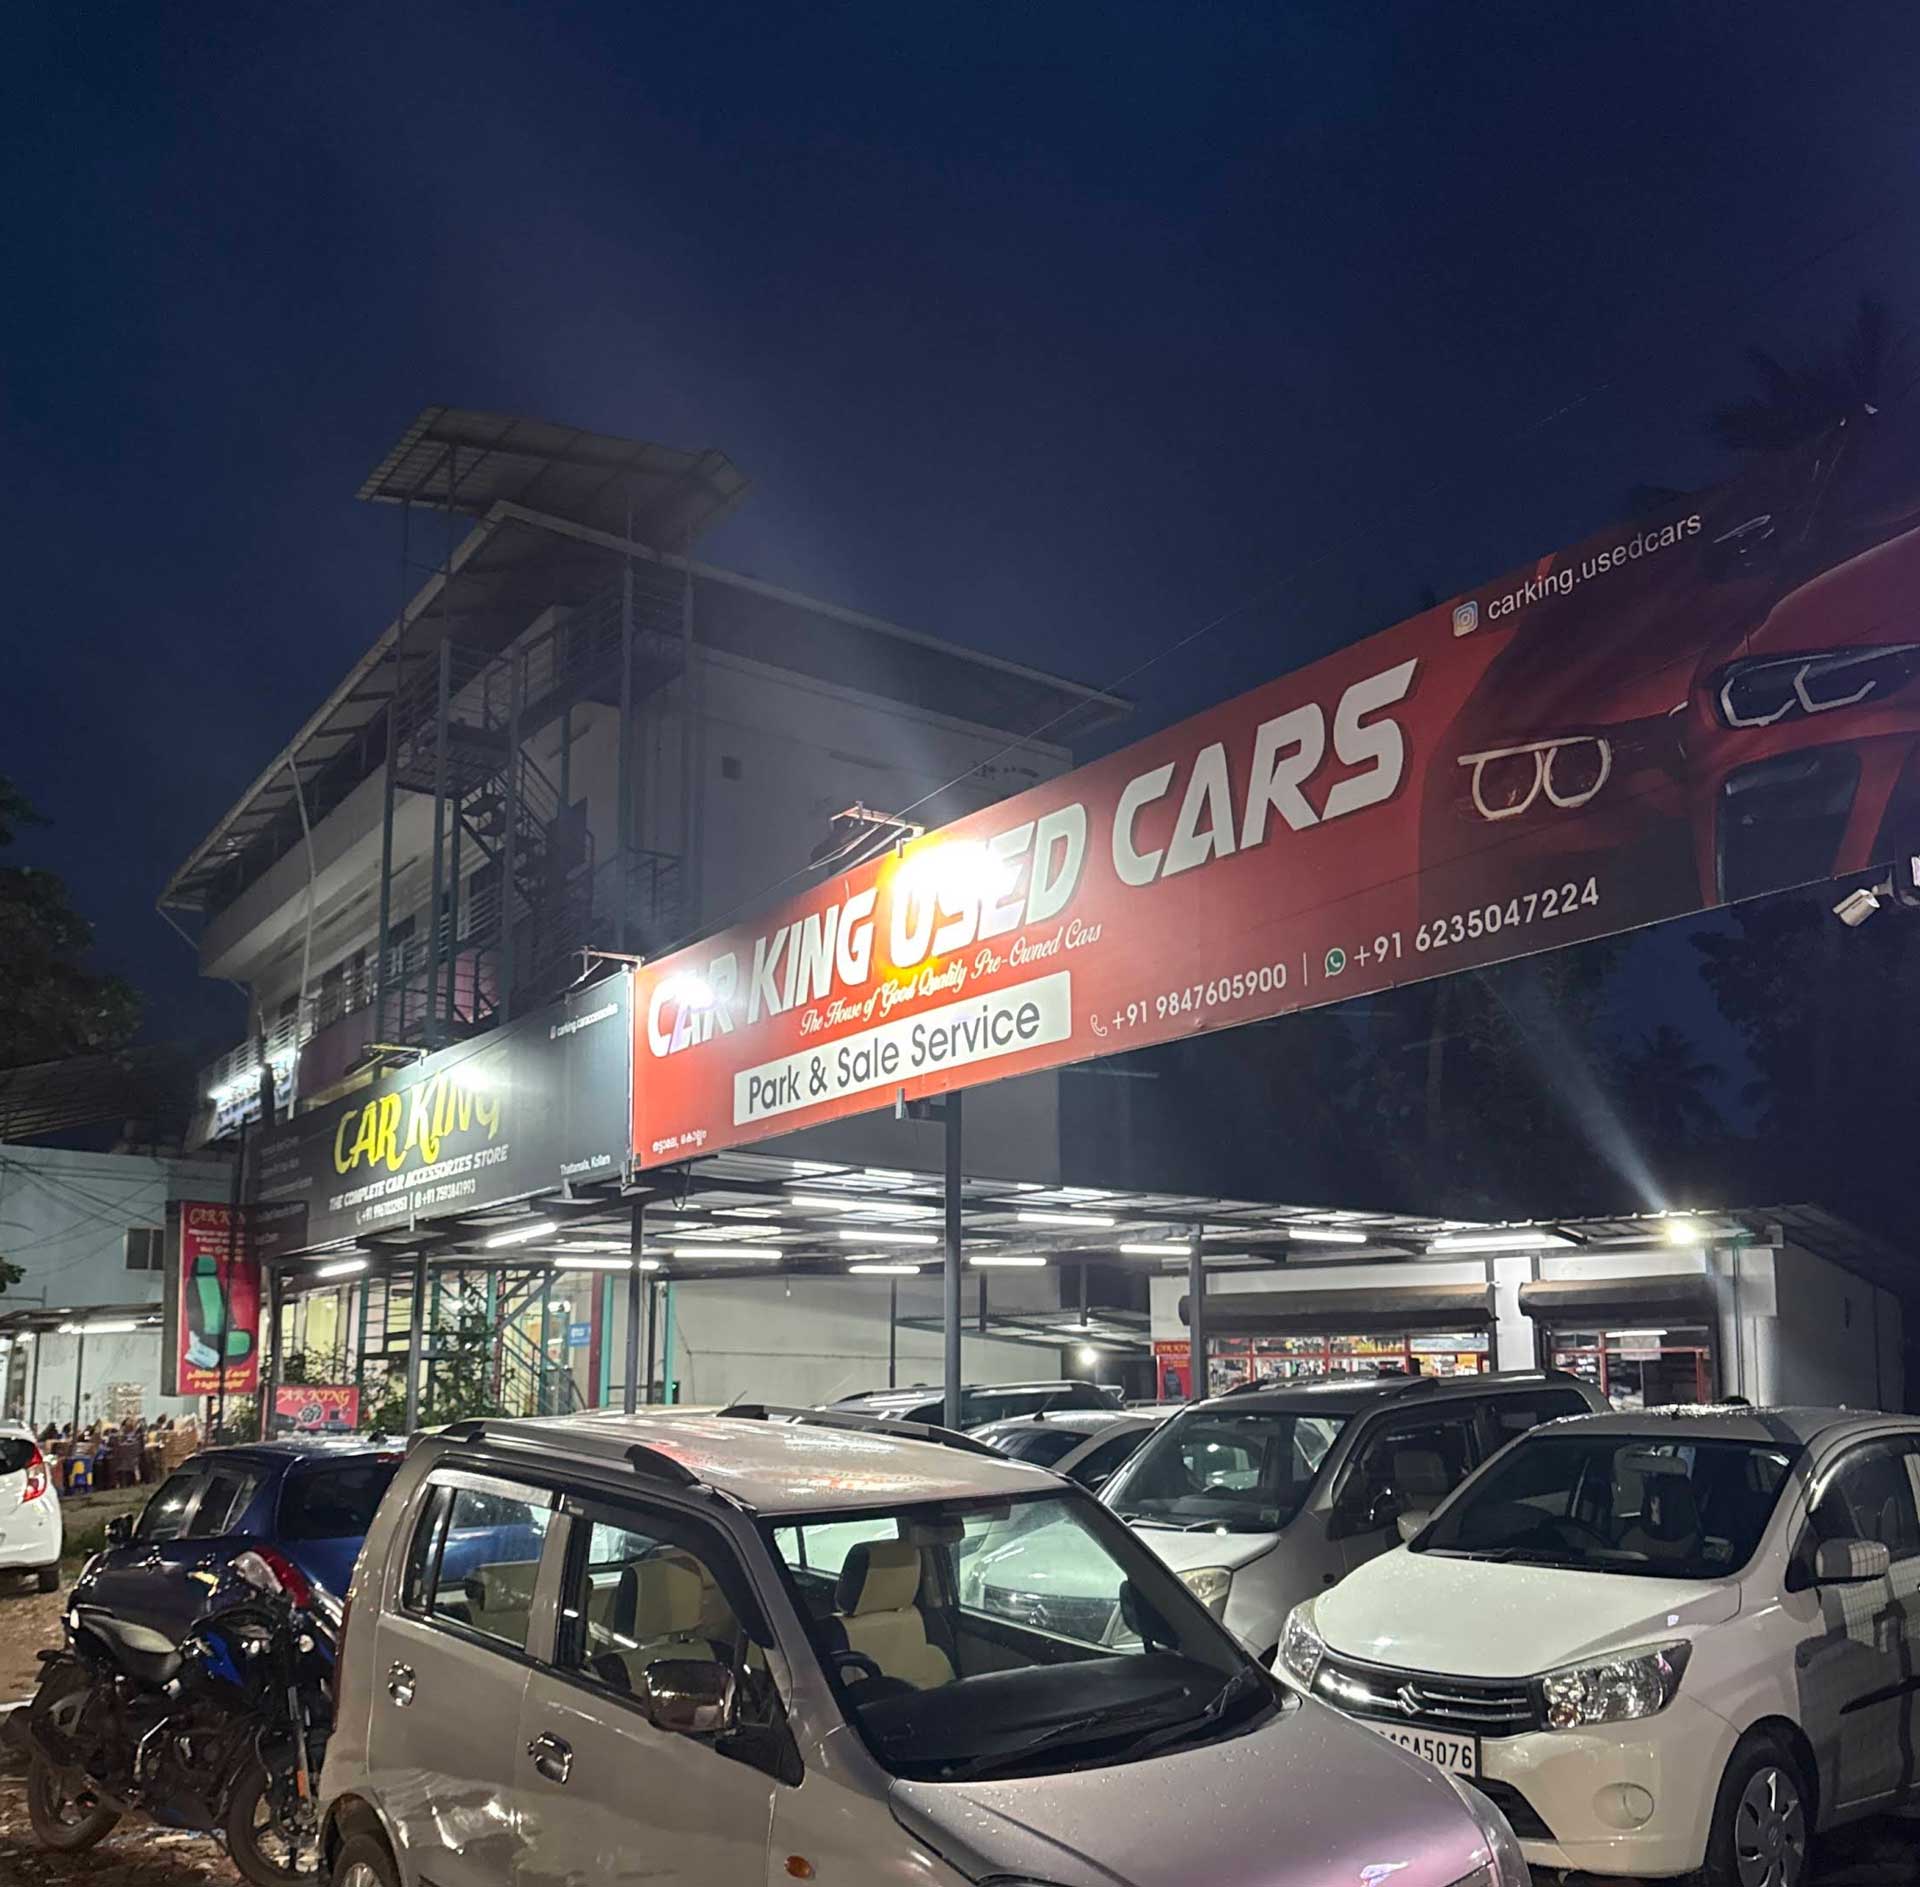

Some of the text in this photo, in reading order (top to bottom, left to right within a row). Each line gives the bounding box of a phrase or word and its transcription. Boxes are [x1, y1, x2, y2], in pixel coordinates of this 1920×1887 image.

[1488, 513, 1701, 620] carking.usedcars
[648, 657, 1419, 1058] CAR KING USED CARS
[800, 918, 1102, 1036] The House of Good Quality Pre-Owned Cars
[1112, 877, 1600, 1030] +91 9847605900 +91 6235047224
[749, 1002, 1040, 1114] Park & Sale Service
[334, 1092, 408, 1174] CAR
[405, 1070, 501, 1164] KING
[473, 1144, 509, 1170] STORE
